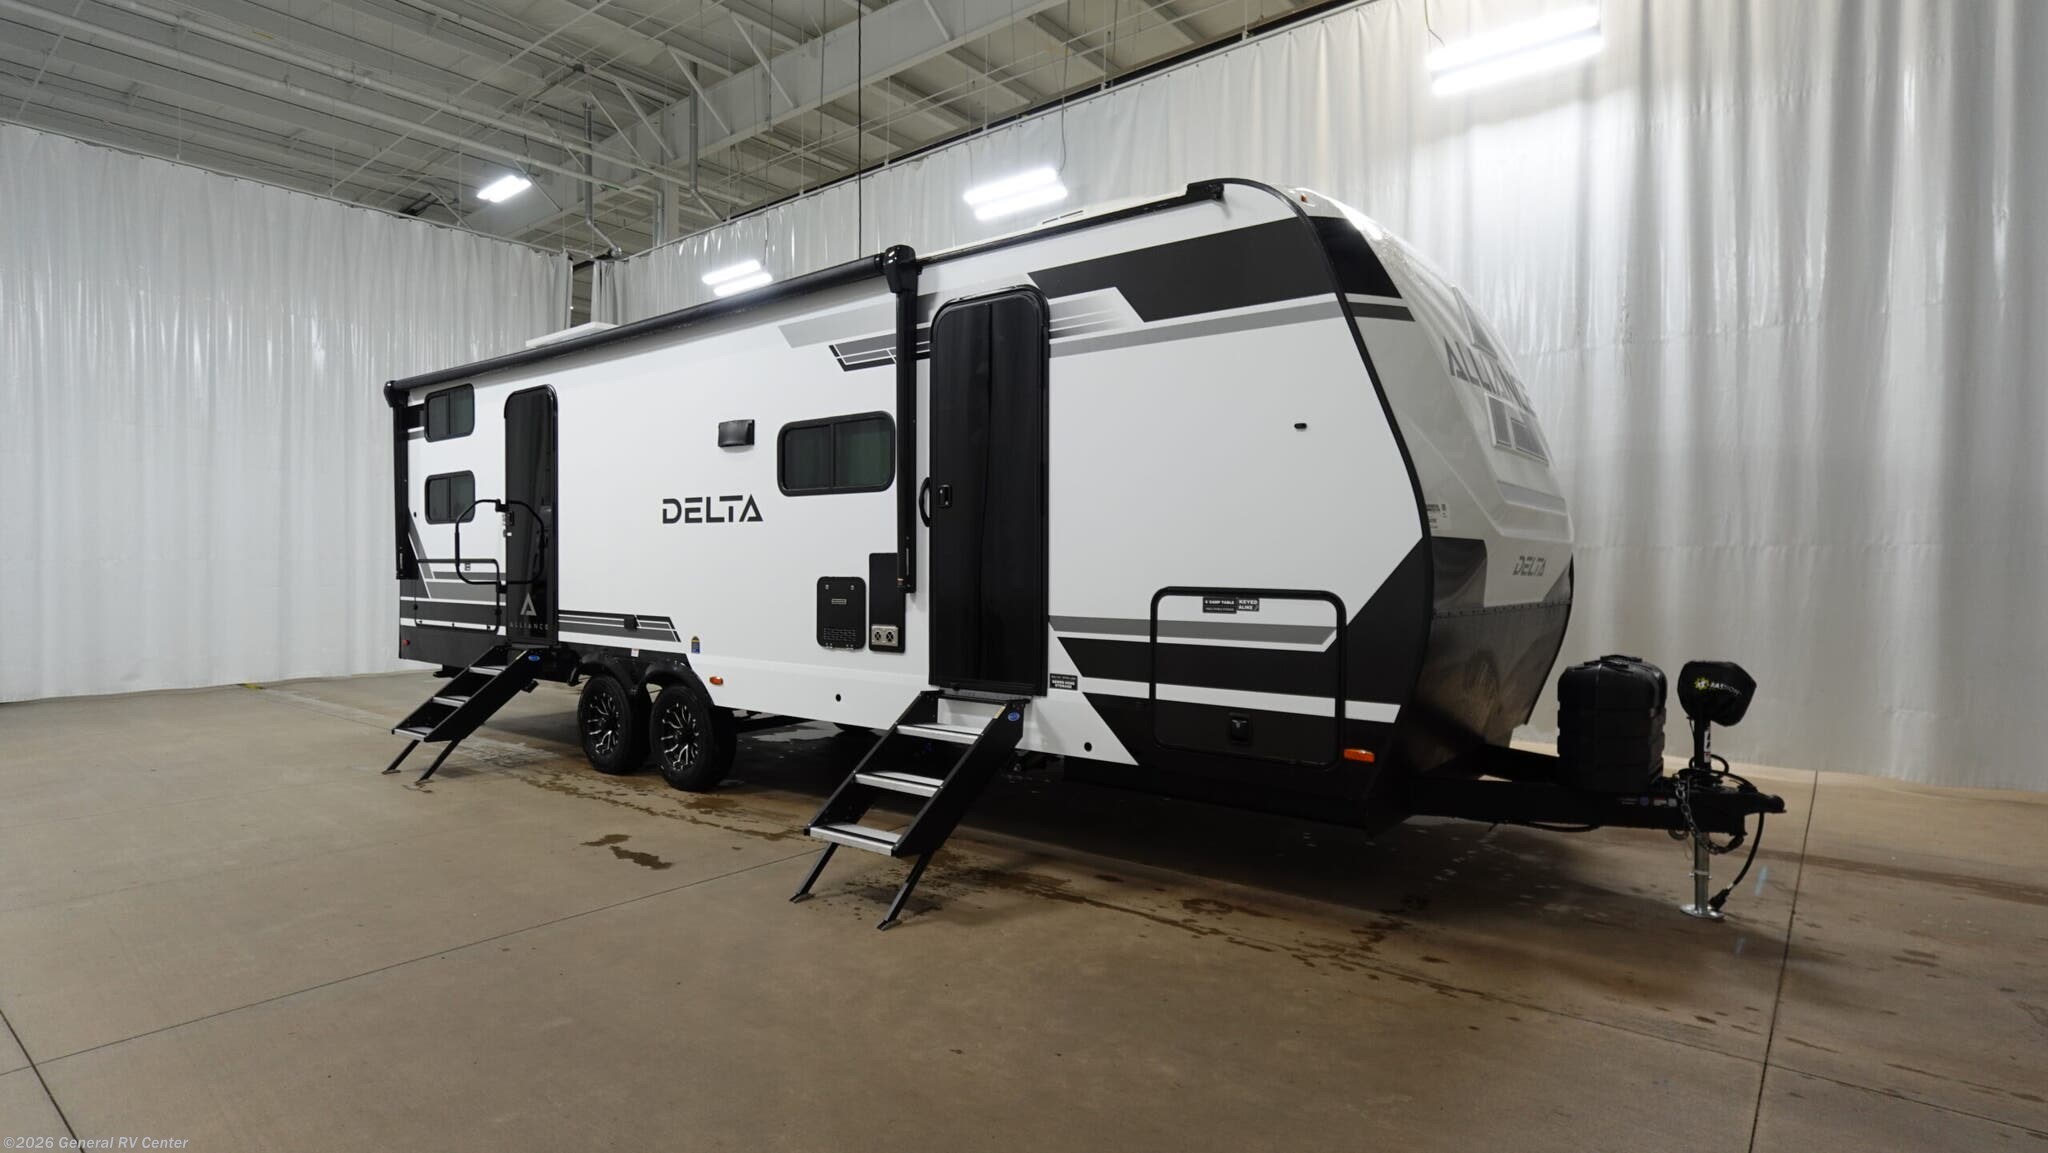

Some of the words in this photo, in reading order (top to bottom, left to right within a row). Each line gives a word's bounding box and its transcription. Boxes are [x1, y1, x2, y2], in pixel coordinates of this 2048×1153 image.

[662, 494, 764, 524] DELTA
[1512, 555, 1547, 577] DELTA
[509, 622, 549, 631] ALLIANCE
